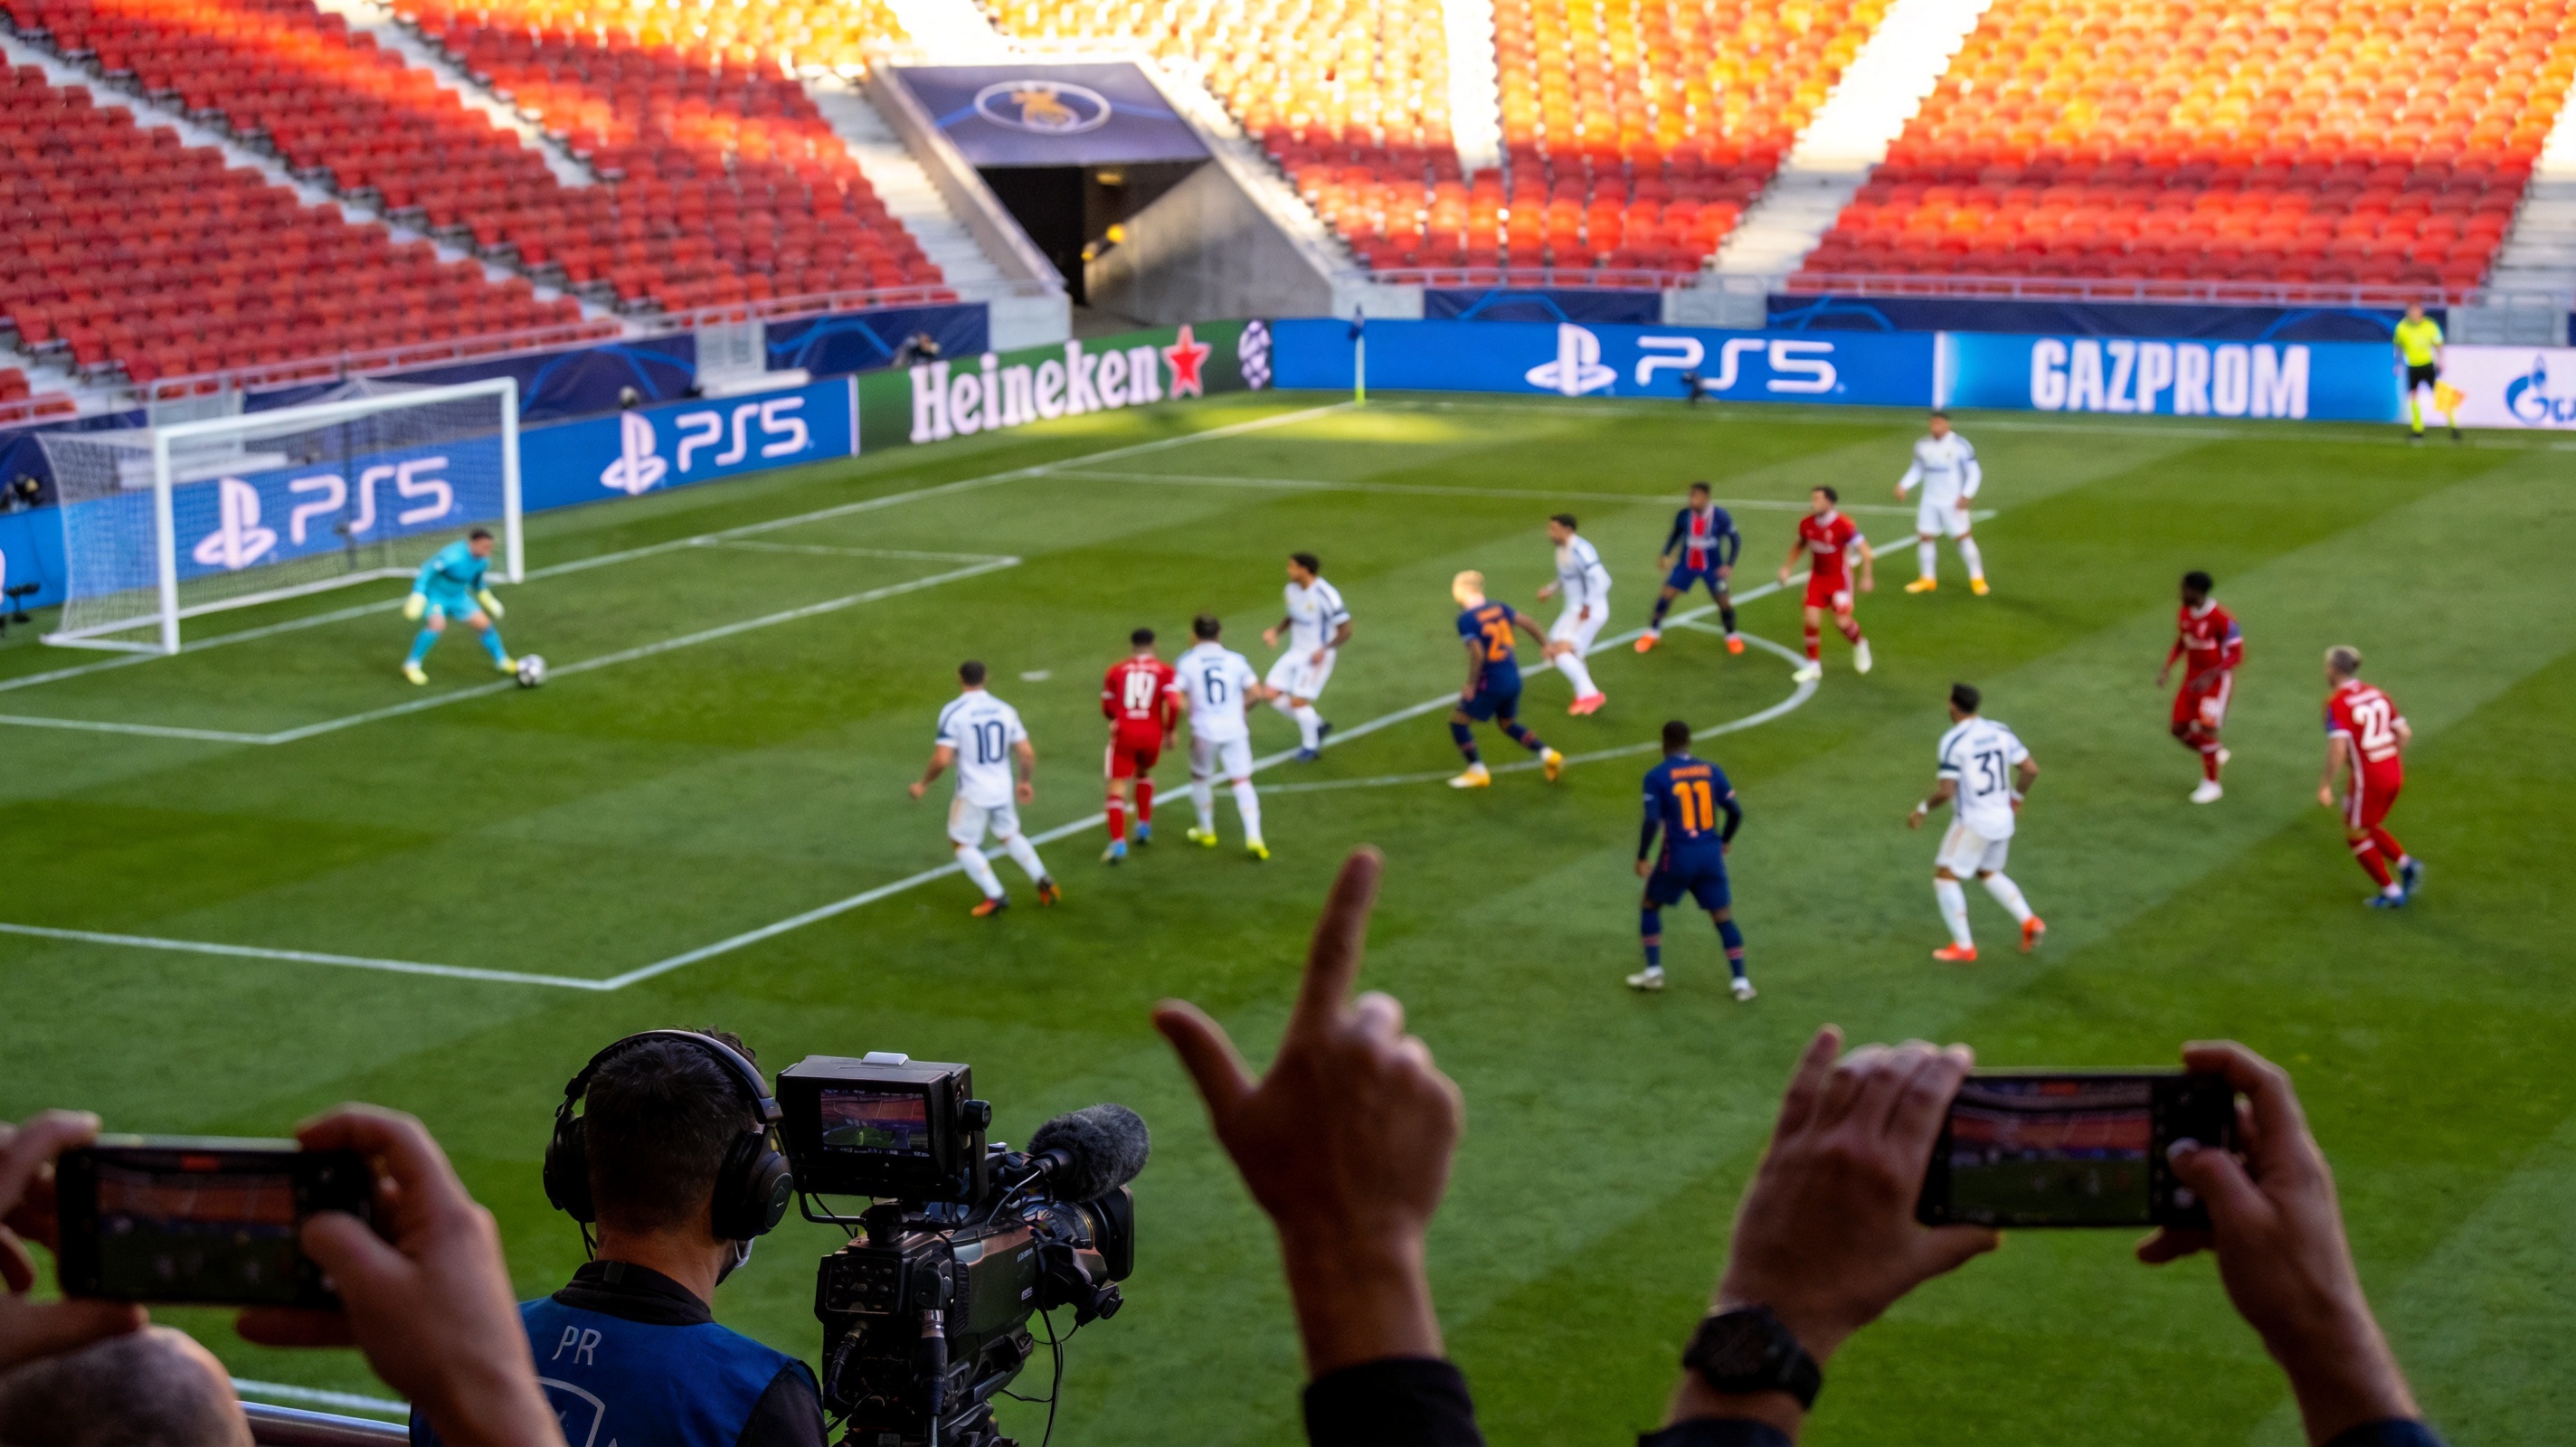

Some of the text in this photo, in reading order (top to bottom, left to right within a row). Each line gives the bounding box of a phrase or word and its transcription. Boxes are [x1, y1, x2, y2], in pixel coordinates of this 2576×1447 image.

[909, 339, 1160, 442] Heineken
[1635, 336, 1837, 393] PS5
[2030, 338, 2310, 420] GAZPROM
[676, 395, 808, 472] PS5
[289, 456, 453, 545] PS5
[1204, 666, 1226, 705] 6
[972, 720, 1006, 764] 10
[2352, 697, 2396, 750] 22
[1974, 749, 2007, 797] 31
[1672, 780, 1715, 831] 11
